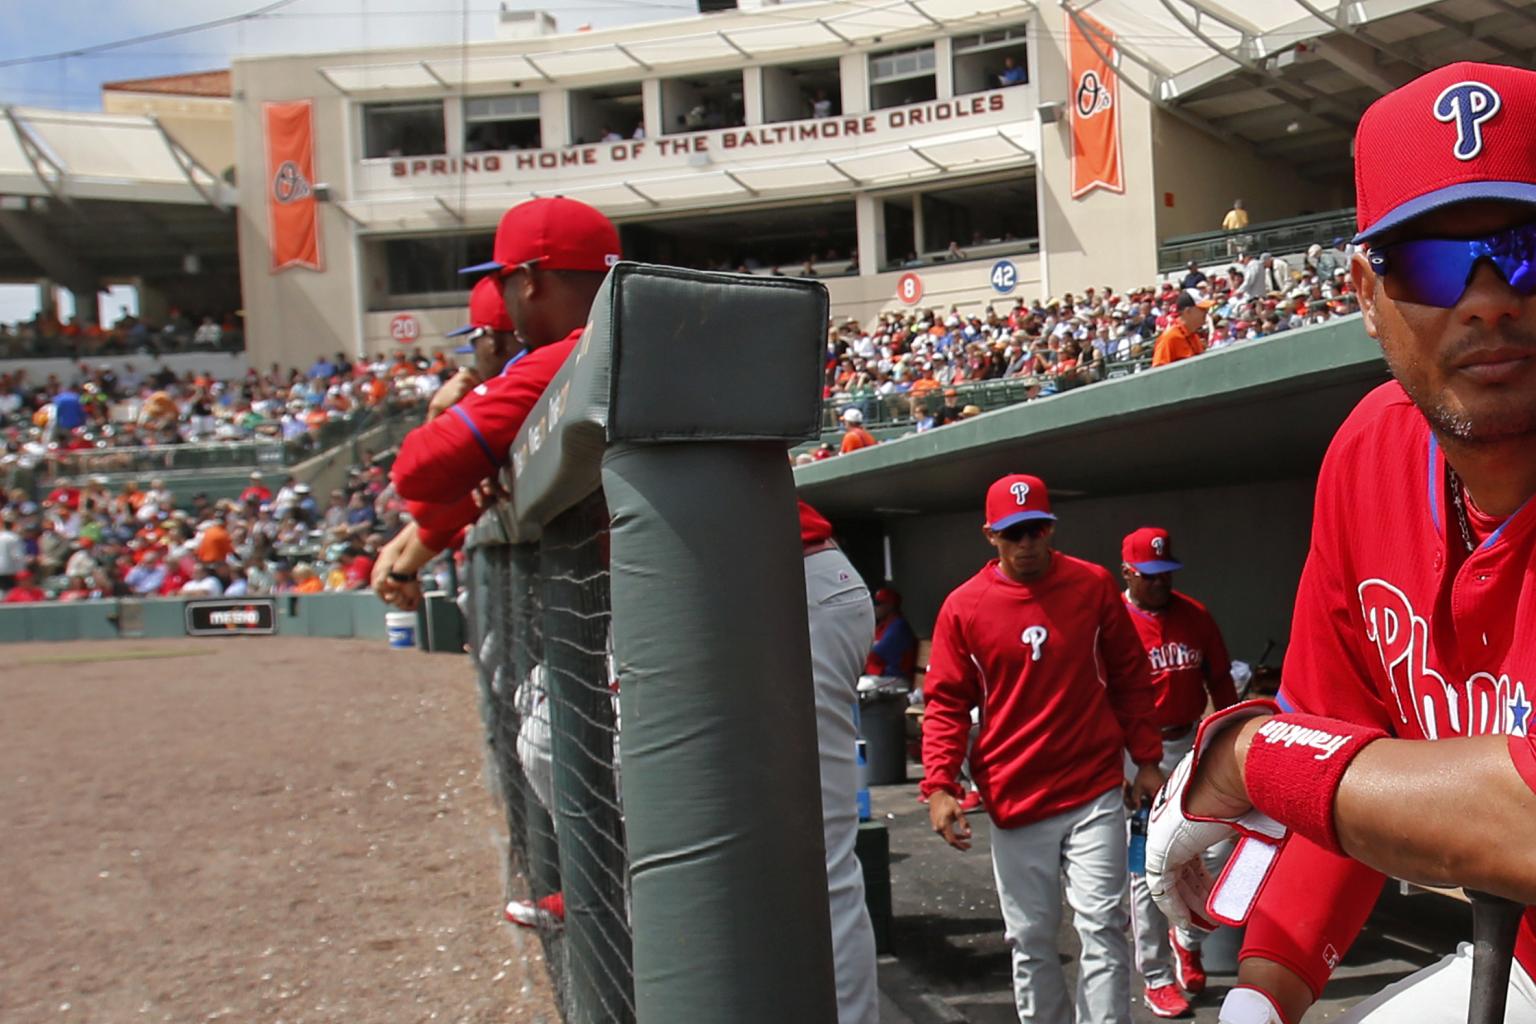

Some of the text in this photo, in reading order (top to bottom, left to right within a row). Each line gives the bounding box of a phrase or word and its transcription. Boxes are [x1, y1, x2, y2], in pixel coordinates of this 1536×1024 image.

[1433, 81, 1501, 160] P
[390, 94, 1005, 178] SPRING HOME OF THE BALTIMORE ORIOLES
[992, 265, 1014, 287] 42
[903, 278, 915, 298] 8
[393, 319, 417, 338] 20
[1010, 481, 1030, 505] P
[1151, 536, 1166, 555] P
[1021, 625, 1048, 661] P
